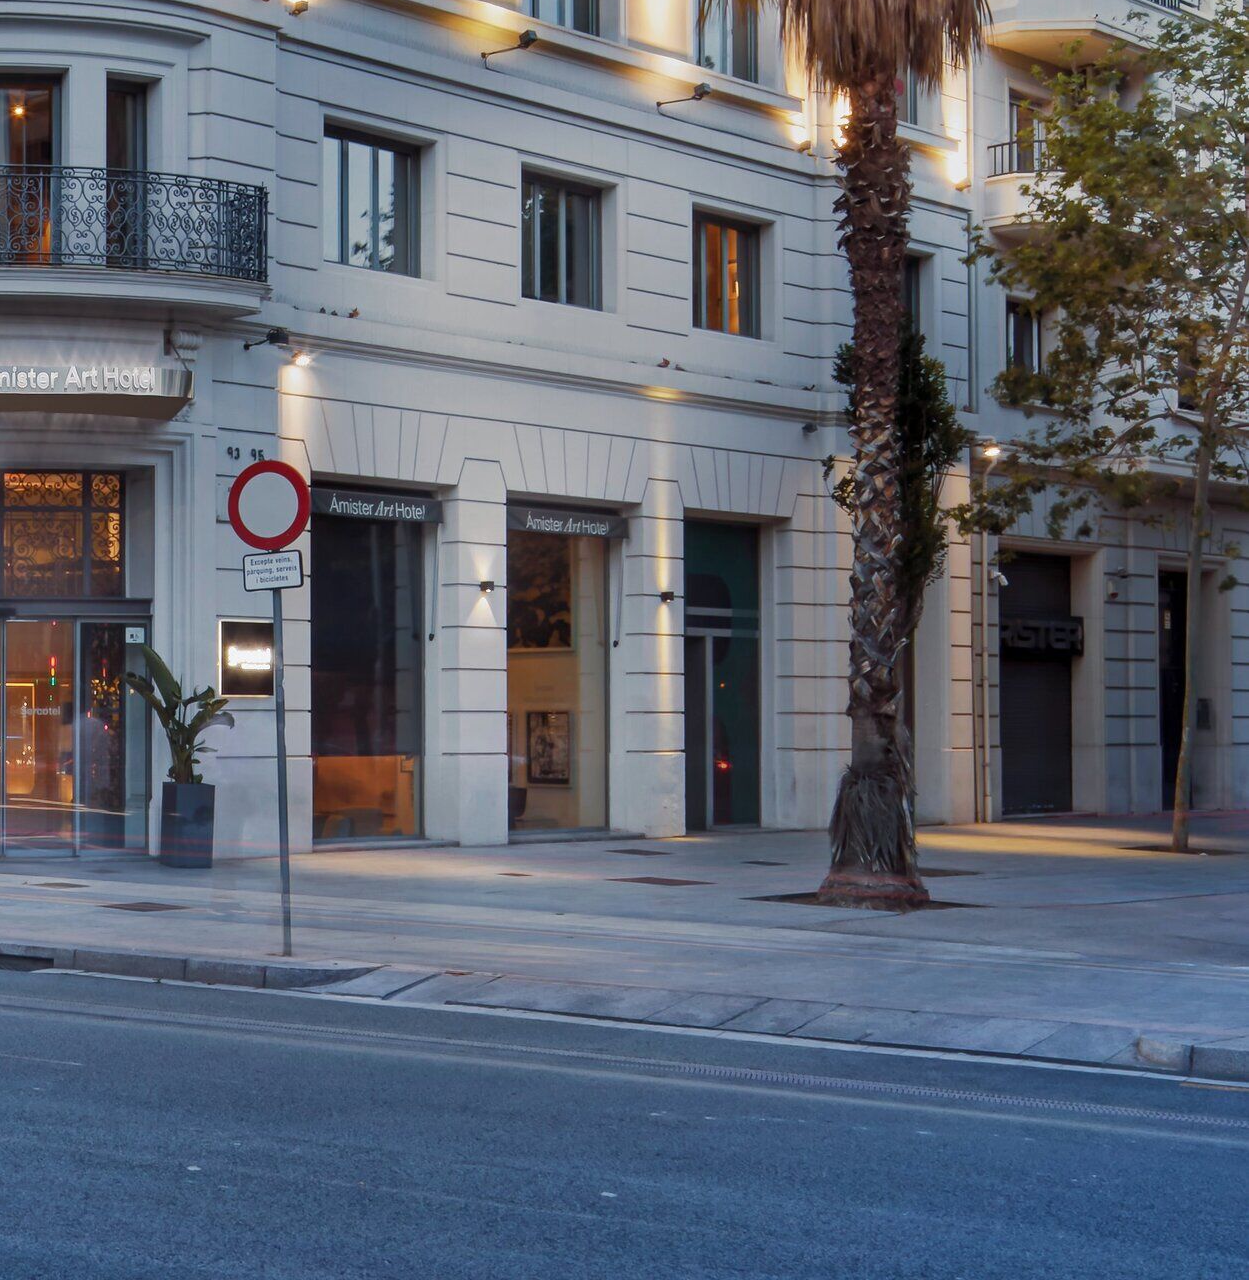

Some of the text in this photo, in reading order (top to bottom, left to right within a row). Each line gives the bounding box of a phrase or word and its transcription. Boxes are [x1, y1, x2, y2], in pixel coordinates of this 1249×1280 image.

[64, 365, 98, 390] Art
[103, 366, 156, 391] Hotel
[227, 446, 265, 461] 93 95
[330, 493, 426, 520] Ámister Art Hotel
[526, 511, 609, 535] Ámister Art Hotel
[250, 557, 273, 566] Excepte
[276, 565, 297, 573] serveis
[260, 575, 288, 583] bicicletes
